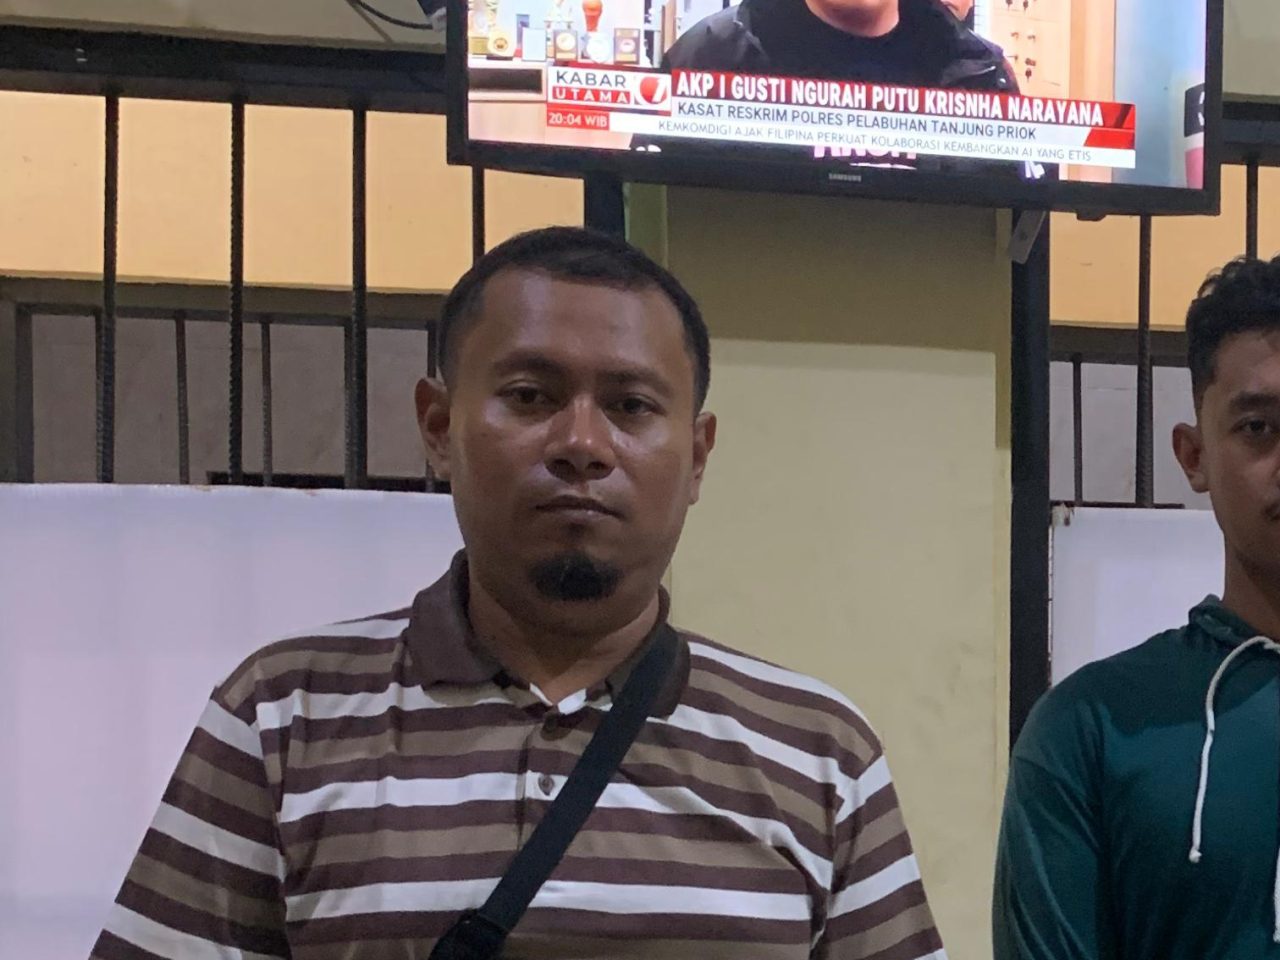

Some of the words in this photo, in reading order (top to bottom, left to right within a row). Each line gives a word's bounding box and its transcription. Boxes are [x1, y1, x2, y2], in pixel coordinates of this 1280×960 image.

[556, 70, 627, 88] KABAR
[555, 87, 629, 104] UTAMA
[677, 71, 714, 97] AKP
[719, 74, 726, 98] I
[731, 75, 786, 102] GUSTI
[791, 79, 867, 109] NGURAH
[871, 85, 920, 113] PUTU
[924, 89, 1003, 118] KRISNHA
[1007, 97, 1104, 126] NARAYANA
[549, 113, 582, 126] 20:04
[585, 115, 608, 127] WIB
[678, 102, 724, 117] KASAT
[728, 105, 788, 121] RESKRIM
[792, 110, 843, 126] POLRES
[847, 114, 927, 132] PELABUHAN
[931, 120, 994, 137] TANJUNG
[997, 125, 1037, 140] PRIOK
[658, 120, 732, 136] KEMKOMDIGI
[735, 126, 764, 138] AJAK
[767, 127, 814, 142] FILIPINA
[817, 132, 867, 145] PERKUAT
[871, 136, 940, 151] KOLABORASI
[944, 141, 1020, 156] KEMBANGKAN
[1021, 147, 1033, 157] AI
[1037, 148, 1065, 160] YANG
[1068, 150, 1091, 162] ETIS
